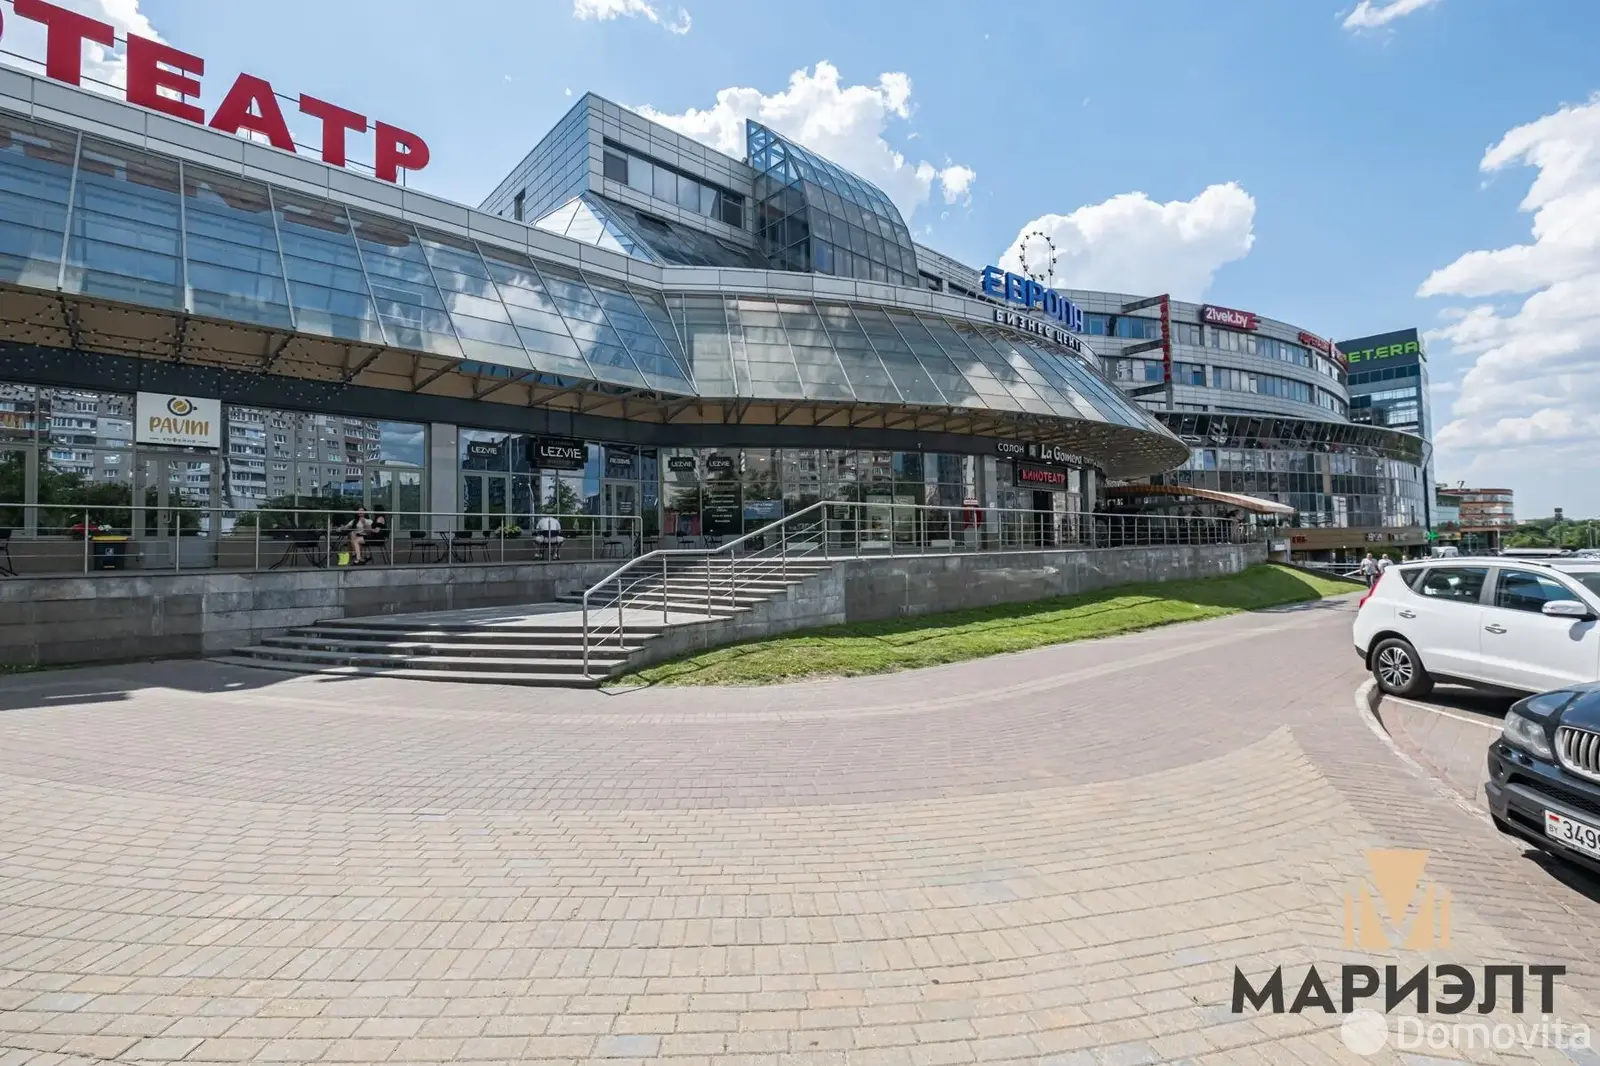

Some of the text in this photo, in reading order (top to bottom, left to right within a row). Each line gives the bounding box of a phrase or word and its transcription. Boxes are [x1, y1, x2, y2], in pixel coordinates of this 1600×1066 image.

[0, 0, 430, 184] ТЕАТР
[994, 309, 1052, 338] БИЗНЕС
[1205, 306, 1249, 328] 21vek.by
[1344, 341, 1419, 364] ET.ERA
[149, 416, 209, 437] PAVINI
[471, 446, 498, 455] LEZVIE
[540, 446, 582, 459] LEZVIE
[1041, 444, 1052, 459] La
[1053, 446, 1082, 465] Gomera
[1022, 469, 1066, 484] КИНОТЕАТР
